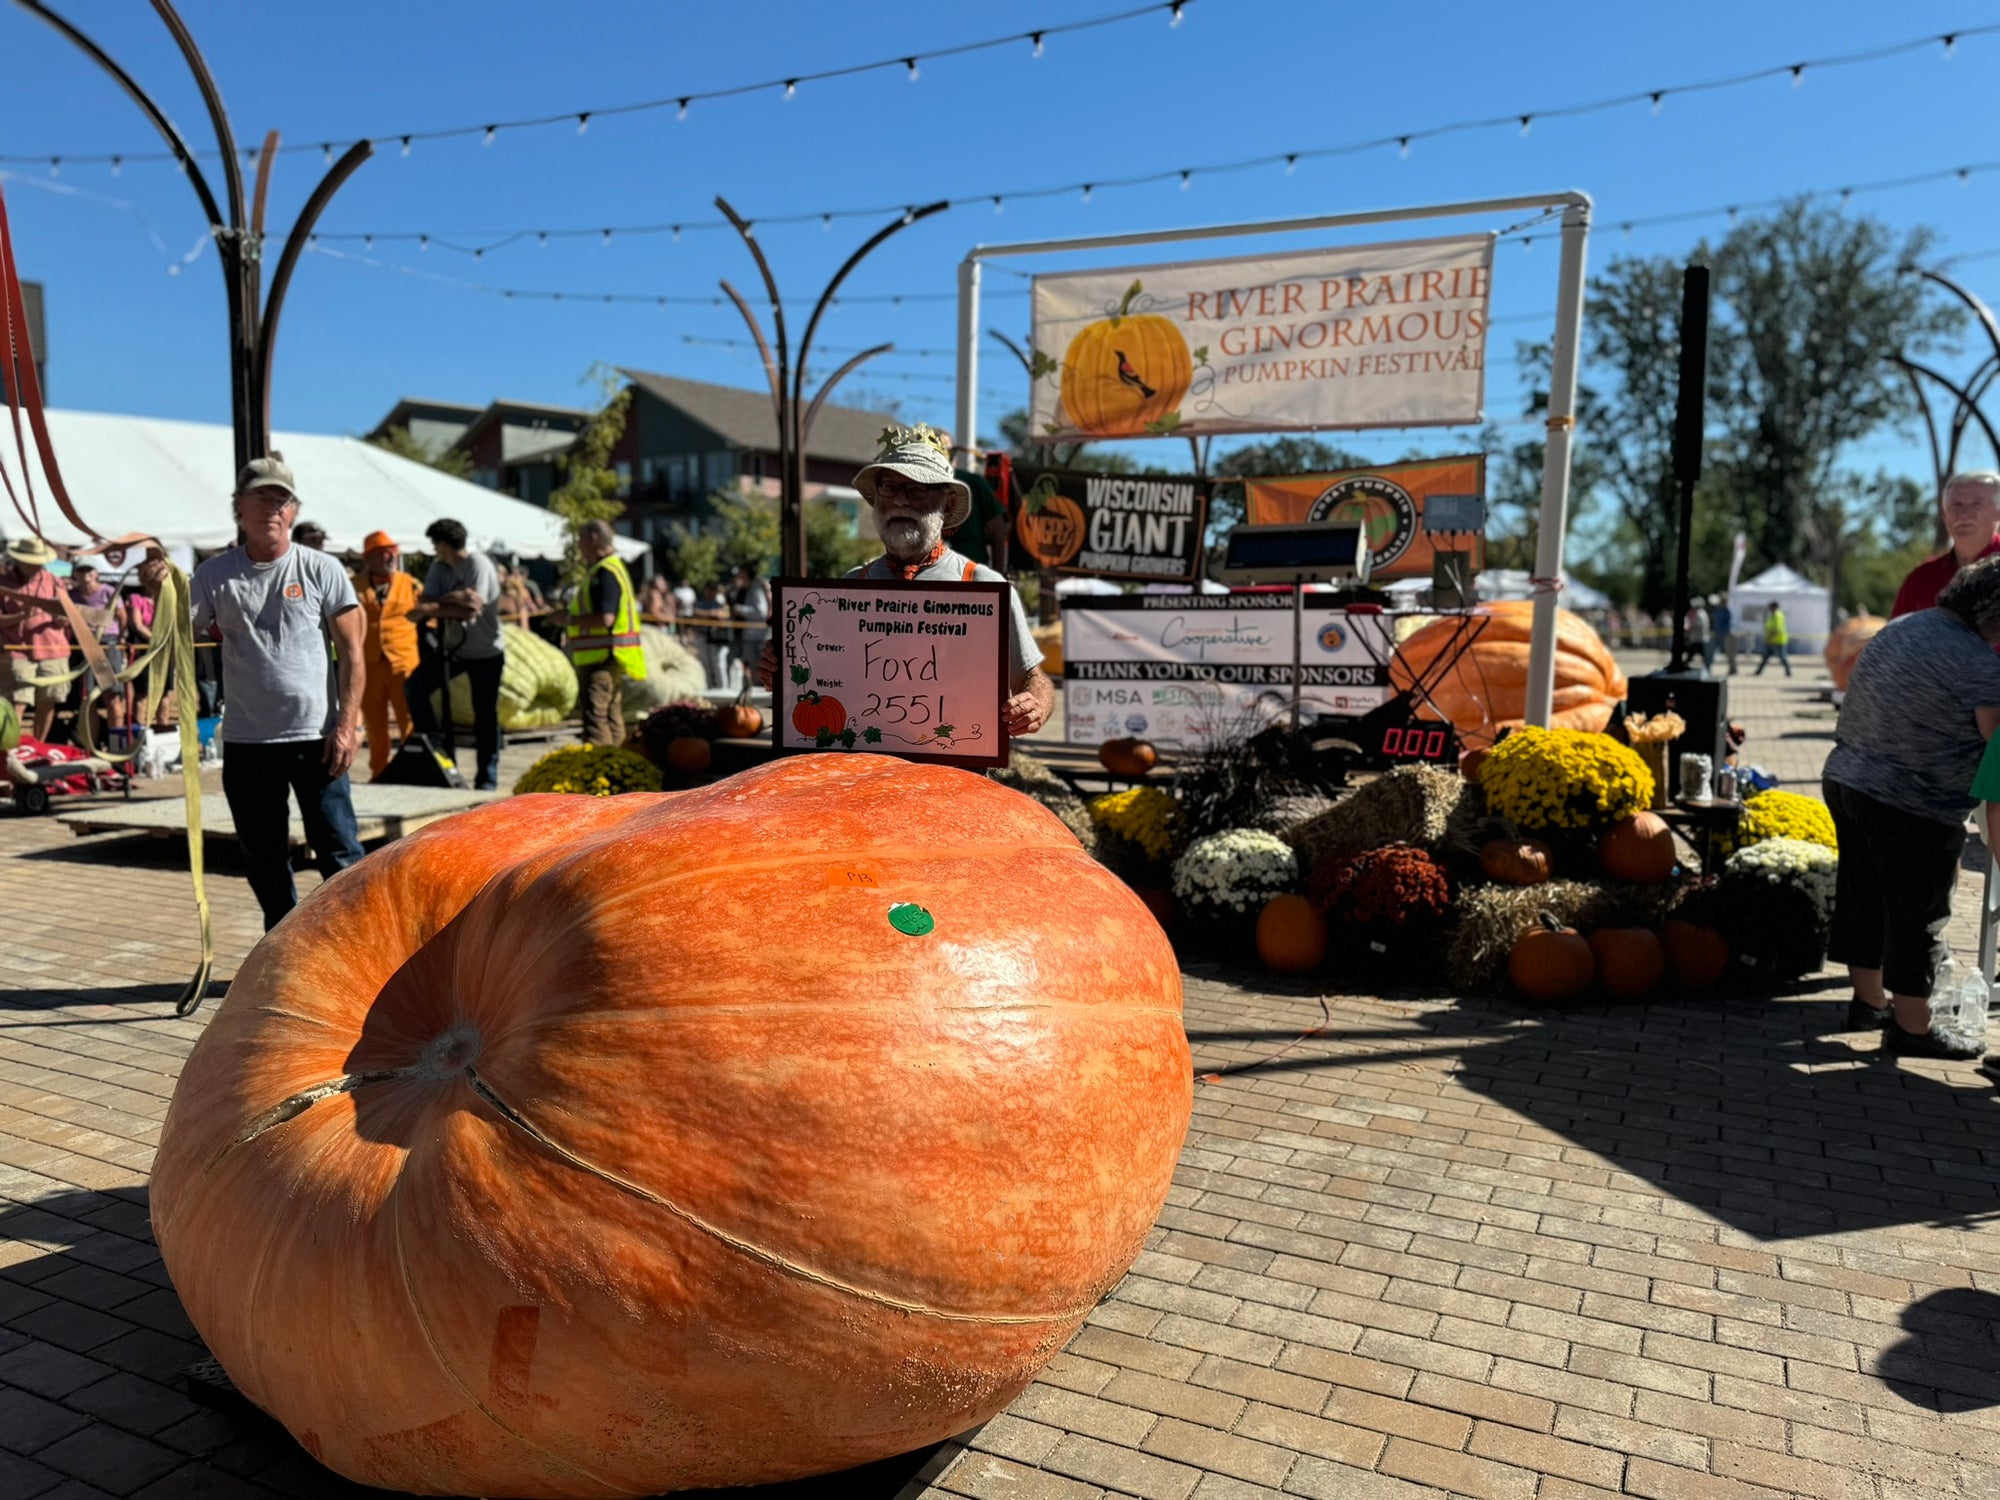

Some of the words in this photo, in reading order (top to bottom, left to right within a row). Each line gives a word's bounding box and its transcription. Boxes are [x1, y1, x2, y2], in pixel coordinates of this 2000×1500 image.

[1186, 284, 1302, 321] RIVER
[1320, 265, 1489, 310] PRAIRIE
[1220, 307, 1486, 356] GINORMOUS
[1223, 355, 1349, 385] PUMPKIN
[1358, 349, 1484, 376] FESTIVAL
[1086, 478, 1195, 514] WISCONSIN
[1312, 485, 1346, 520] GREAT
[1353, 481, 1410, 513] PUMPKIN
[1089, 508, 1193, 557] GIANT
[1079, 551, 1131, 572] PUMPKIN
[1131, 555, 1187, 577] GROWERS
[838, 597, 871, 613] River
[875, 598, 918, 614] Prairie
[923, 600, 993, 616] Ginormous
[1143, 594, 1226, 609] PRESENTING
[1228, 594, 1293, 608] SPONSOR
[786, 600, 797, 664] 2024
[858, 619, 913, 636] Pumpkin
[917, 621, 967, 636] Festival
[1160, 615, 1274, 659] Cooperative
[864, 639, 938, 682] Ford
[1074, 662, 1143, 679] THANK
[1144, 663, 1186, 679] YOU
[1187, 665, 1217, 680] TO
[1218, 666, 1265, 682] OUR
[1268, 665, 1376, 685] SPONSORS
[816, 678, 843, 689] Weight:
[1096, 689, 1143, 705] MSA
[861, 693, 944, 725] 2551
[1382, 728, 1445, 757] 0.00
